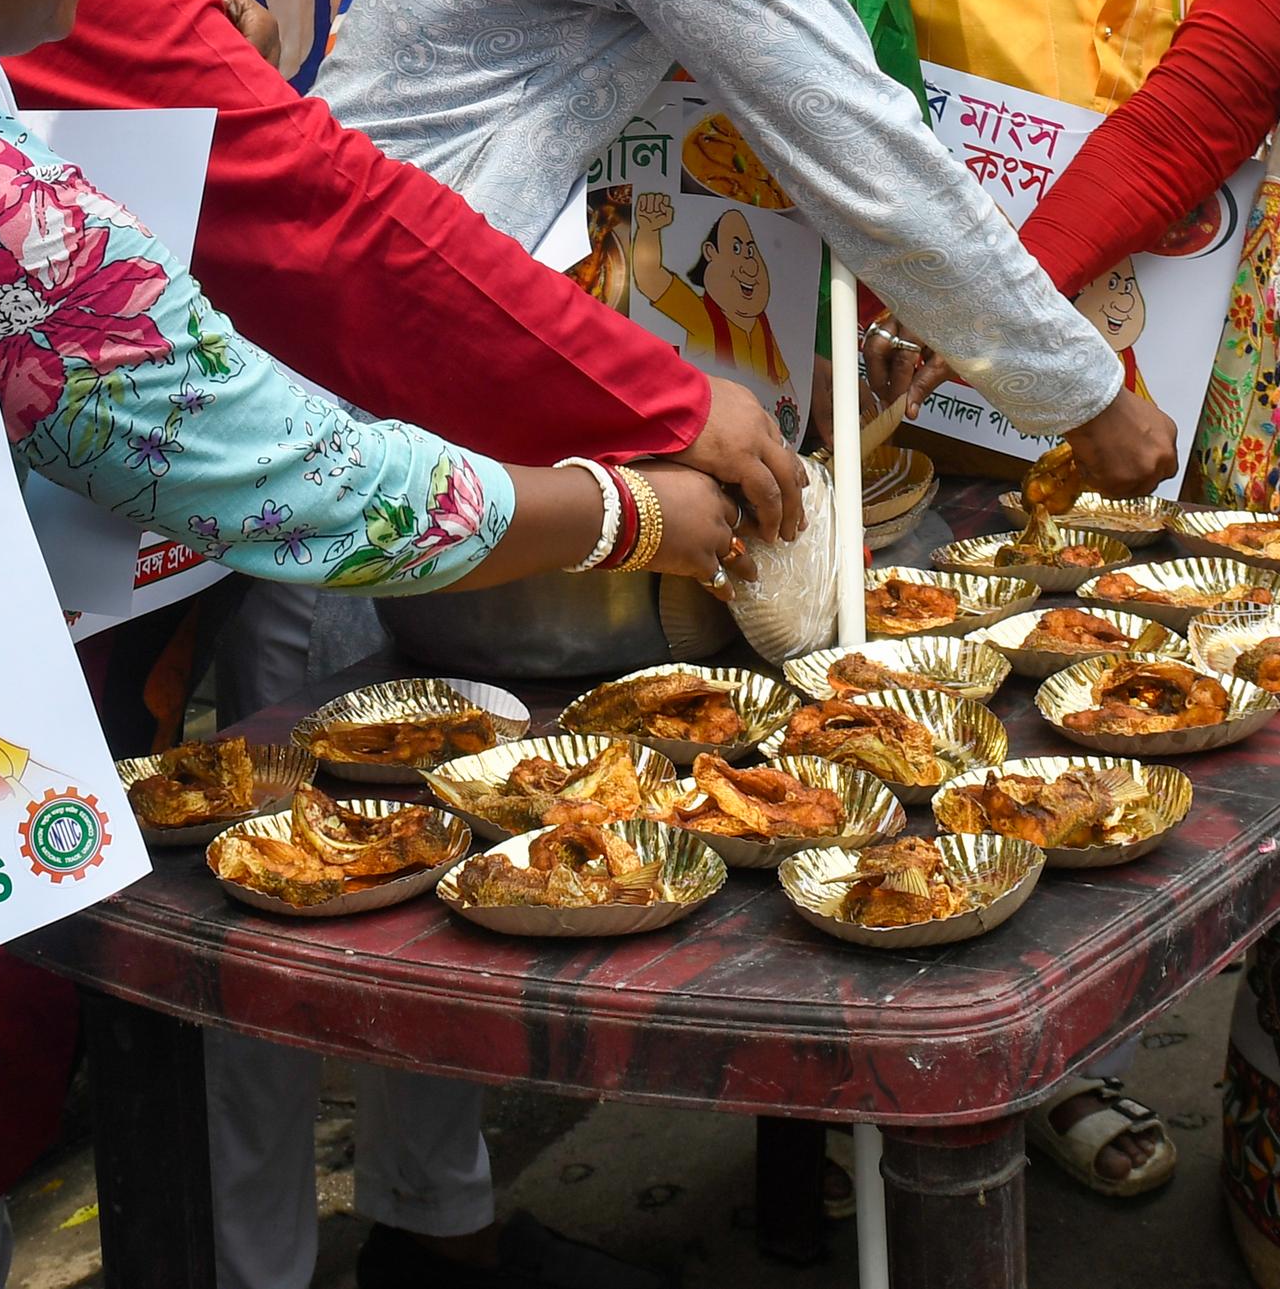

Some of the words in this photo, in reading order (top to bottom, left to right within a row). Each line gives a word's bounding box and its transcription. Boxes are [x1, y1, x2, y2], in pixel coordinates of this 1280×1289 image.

[959, 95, 1065, 159] মাংস
[962, 143, 1054, 201] কংস
[48, 819, 82, 851] INTUC
